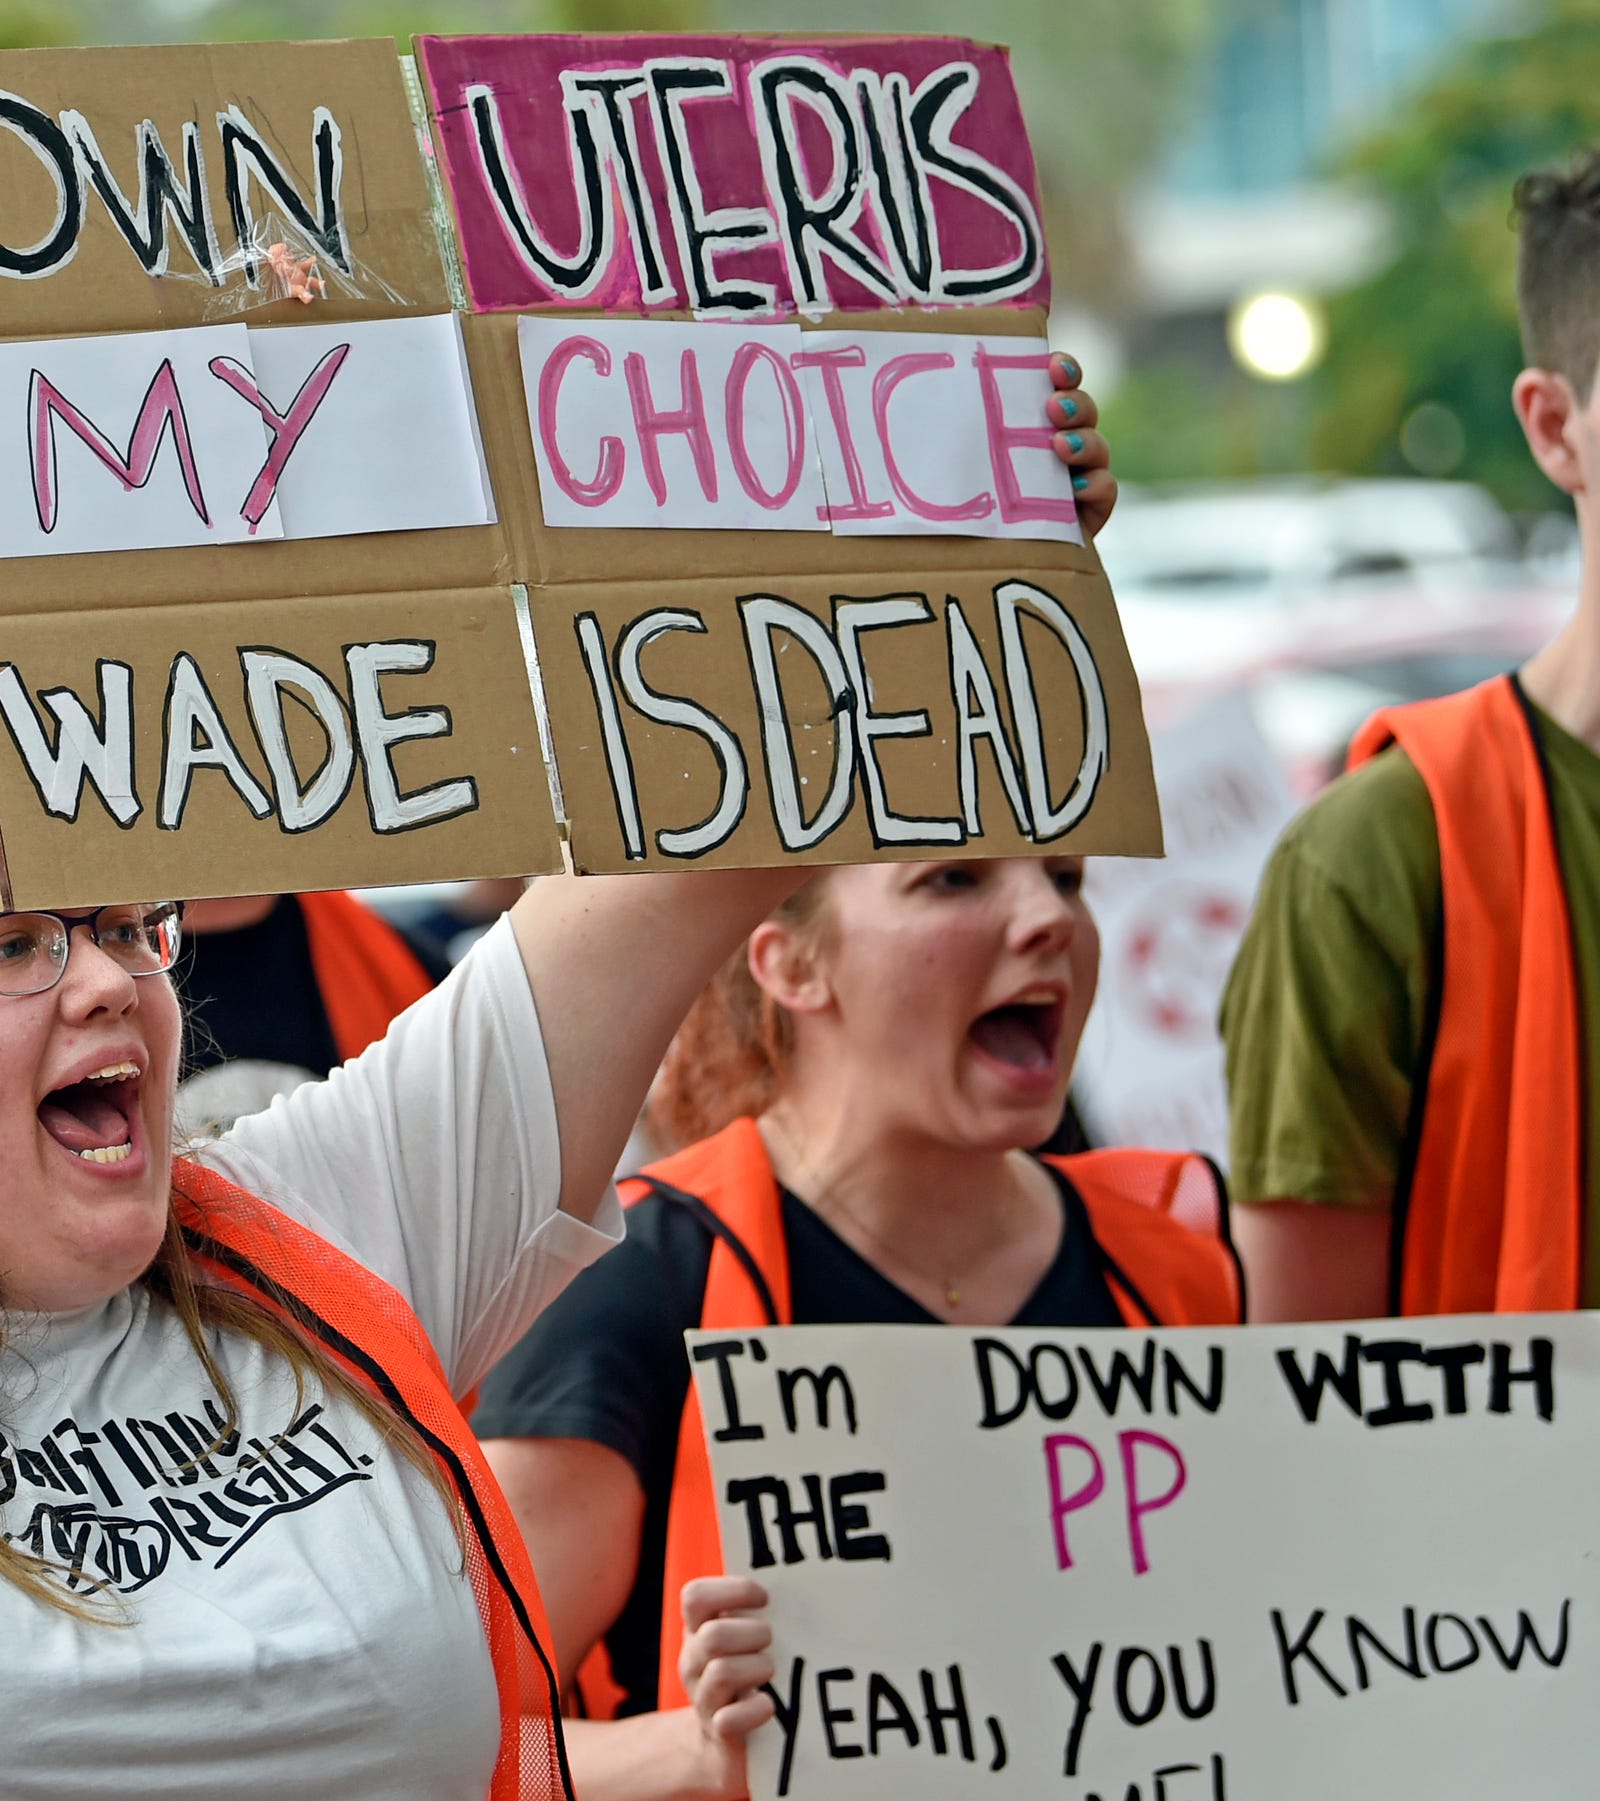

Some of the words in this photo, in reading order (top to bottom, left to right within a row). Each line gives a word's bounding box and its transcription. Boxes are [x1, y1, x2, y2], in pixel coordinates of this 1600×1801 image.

[465, 55, 1043, 320] UTERUS
[27, 343, 350, 534] MY
[538, 334, 1078, 524] CHOICE
[573, 607, 750, 861] IS
[736, 578, 1111, 853] DEAD
[692, 1338, 857, 1442] I'm
[972, 1338, 1223, 1429] DOWN
[1275, 1333, 1554, 1429] WITH
[727, 1471, 891, 1570] THE
[1043, 1428, 1187, 1576] PP
[756, 1656, 1007, 1797] YEAH,
[1051, 1641, 1216, 1777] YOU
[1270, 1597, 1571, 1706] KNOW
